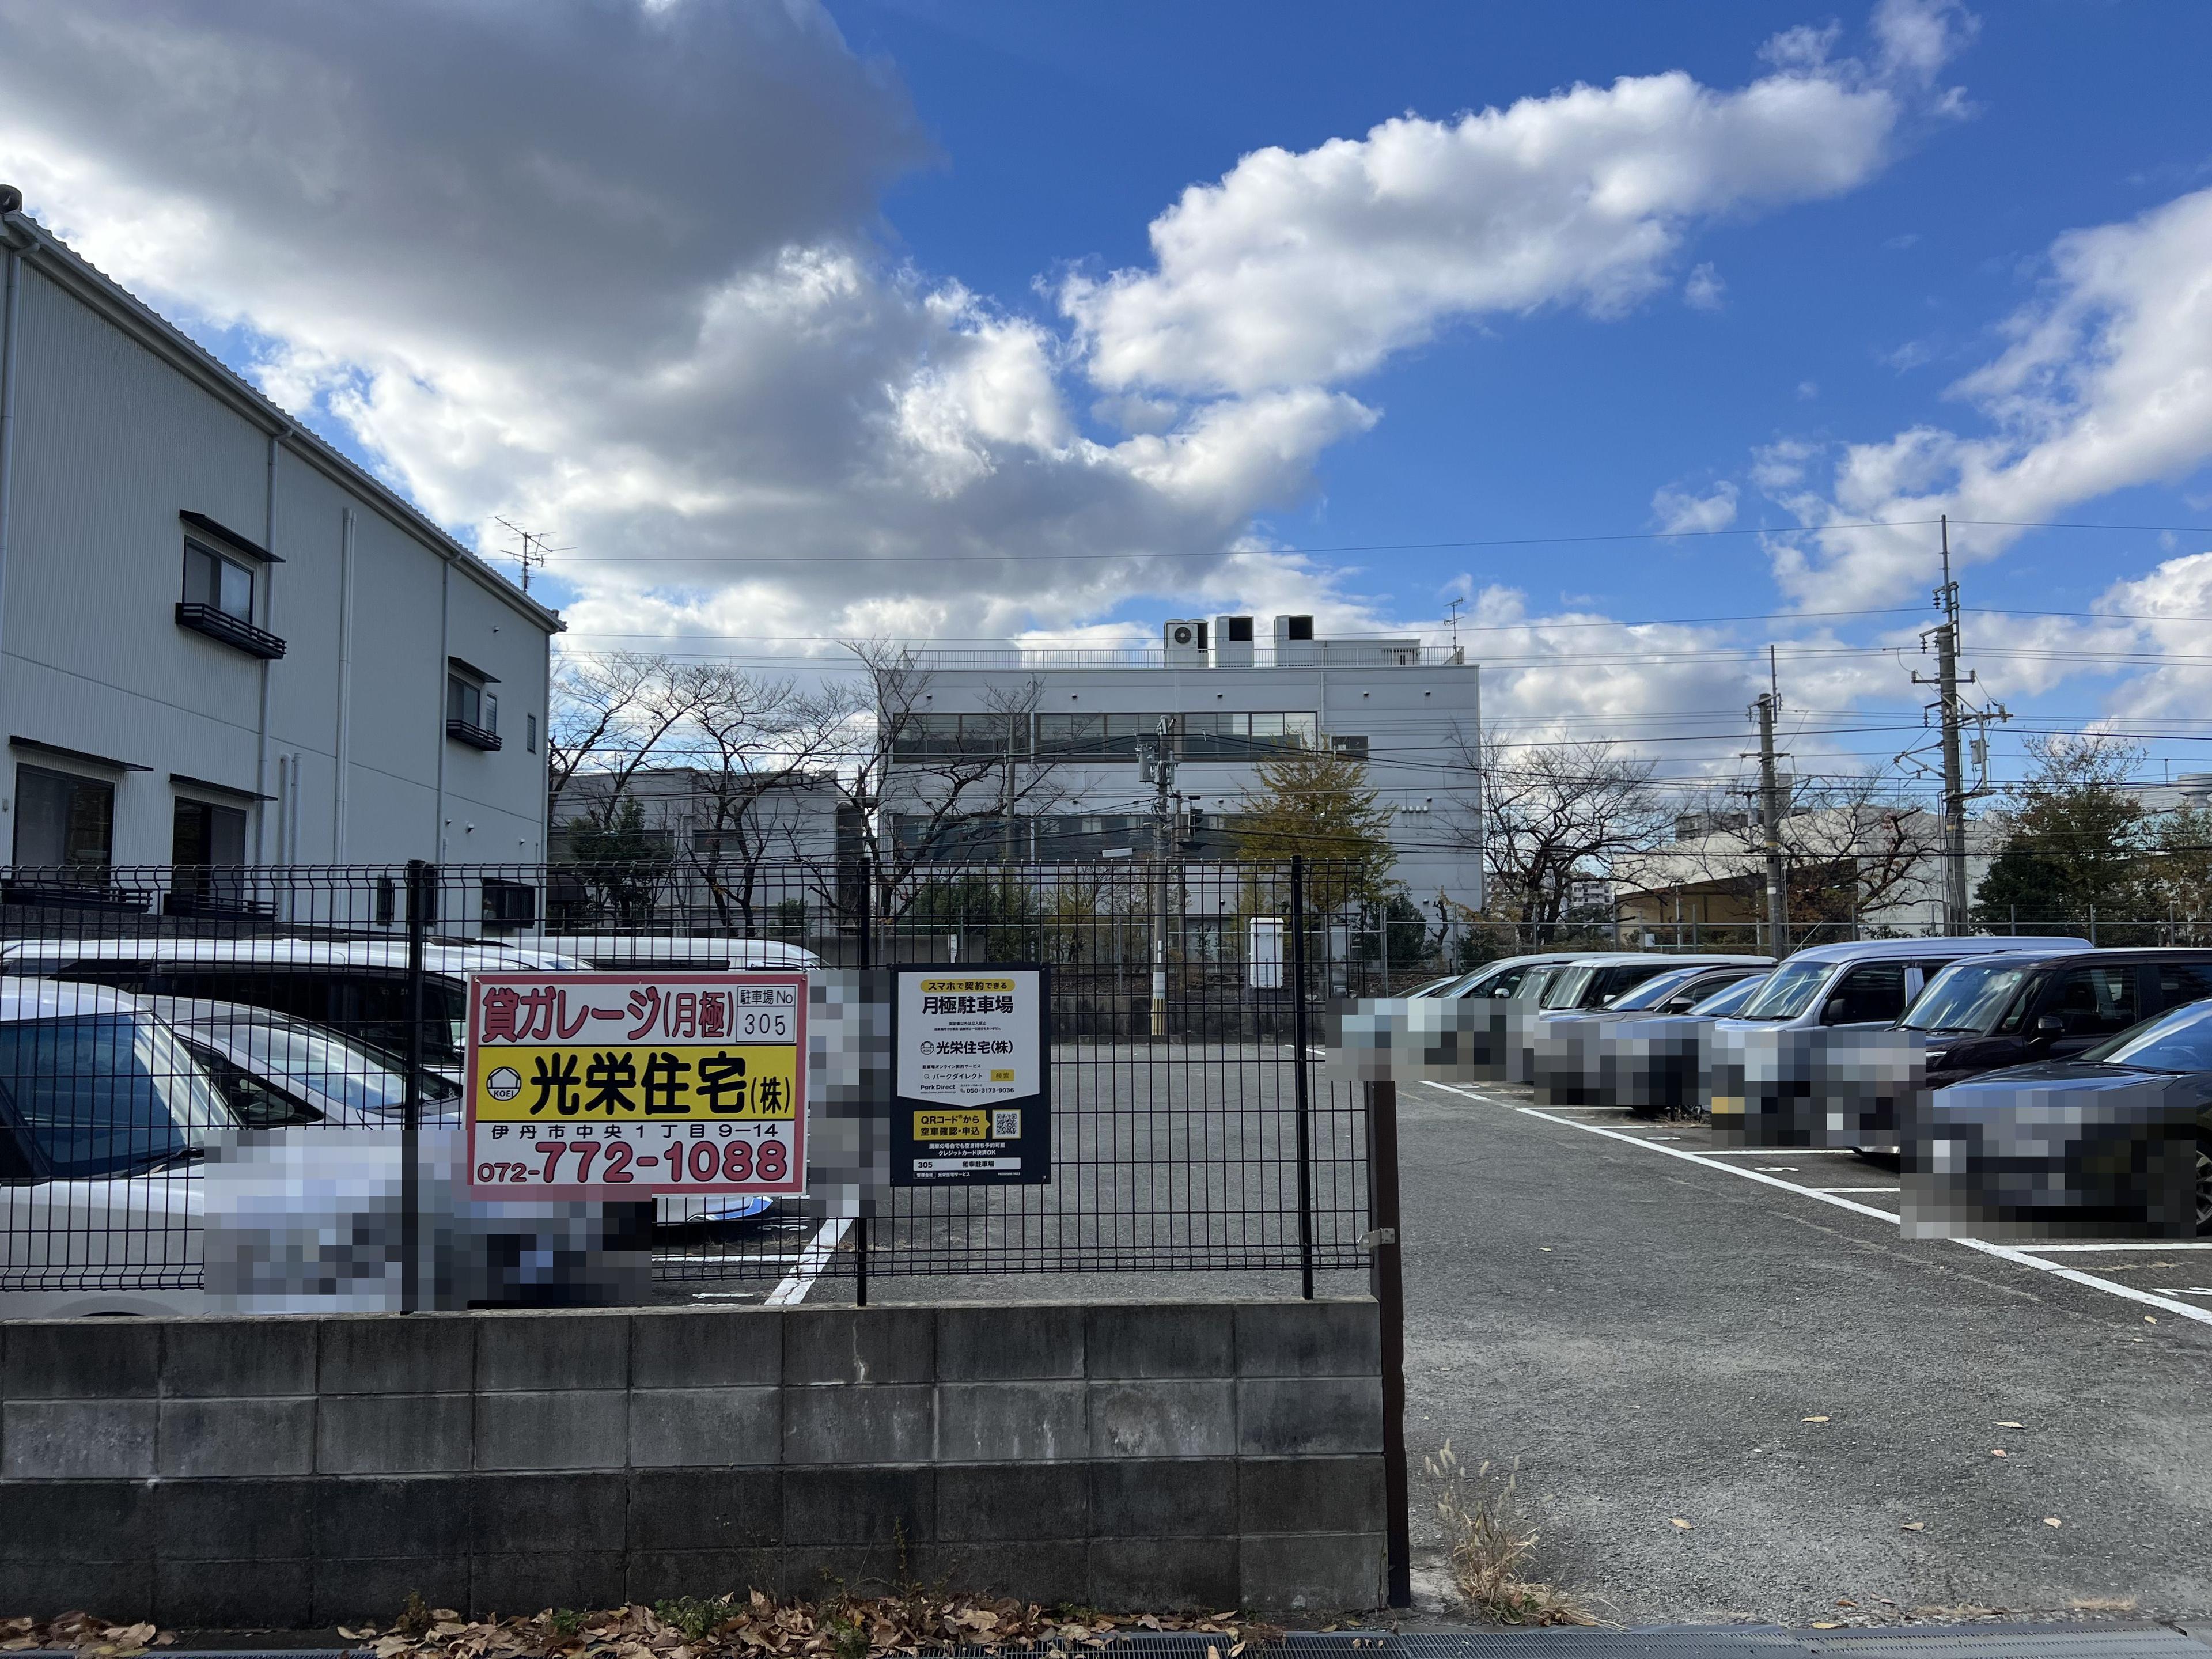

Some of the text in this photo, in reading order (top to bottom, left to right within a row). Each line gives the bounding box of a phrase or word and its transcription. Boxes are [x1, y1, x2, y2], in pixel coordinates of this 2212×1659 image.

[928, 981, 1007, 991] スマホで契約できる
[482, 985, 734, 1041] 貸ガレージ(月極)
[922, 995, 1014, 1014] 月極駐車場
[744, 1013, 786, 1036] 305
[936, 1040, 1013, 1055] 光栄住宅(株)
[529, 1051, 790, 1115] 光栄住宅(株)
[477, 1140, 788, 1183] 072-772-1088
